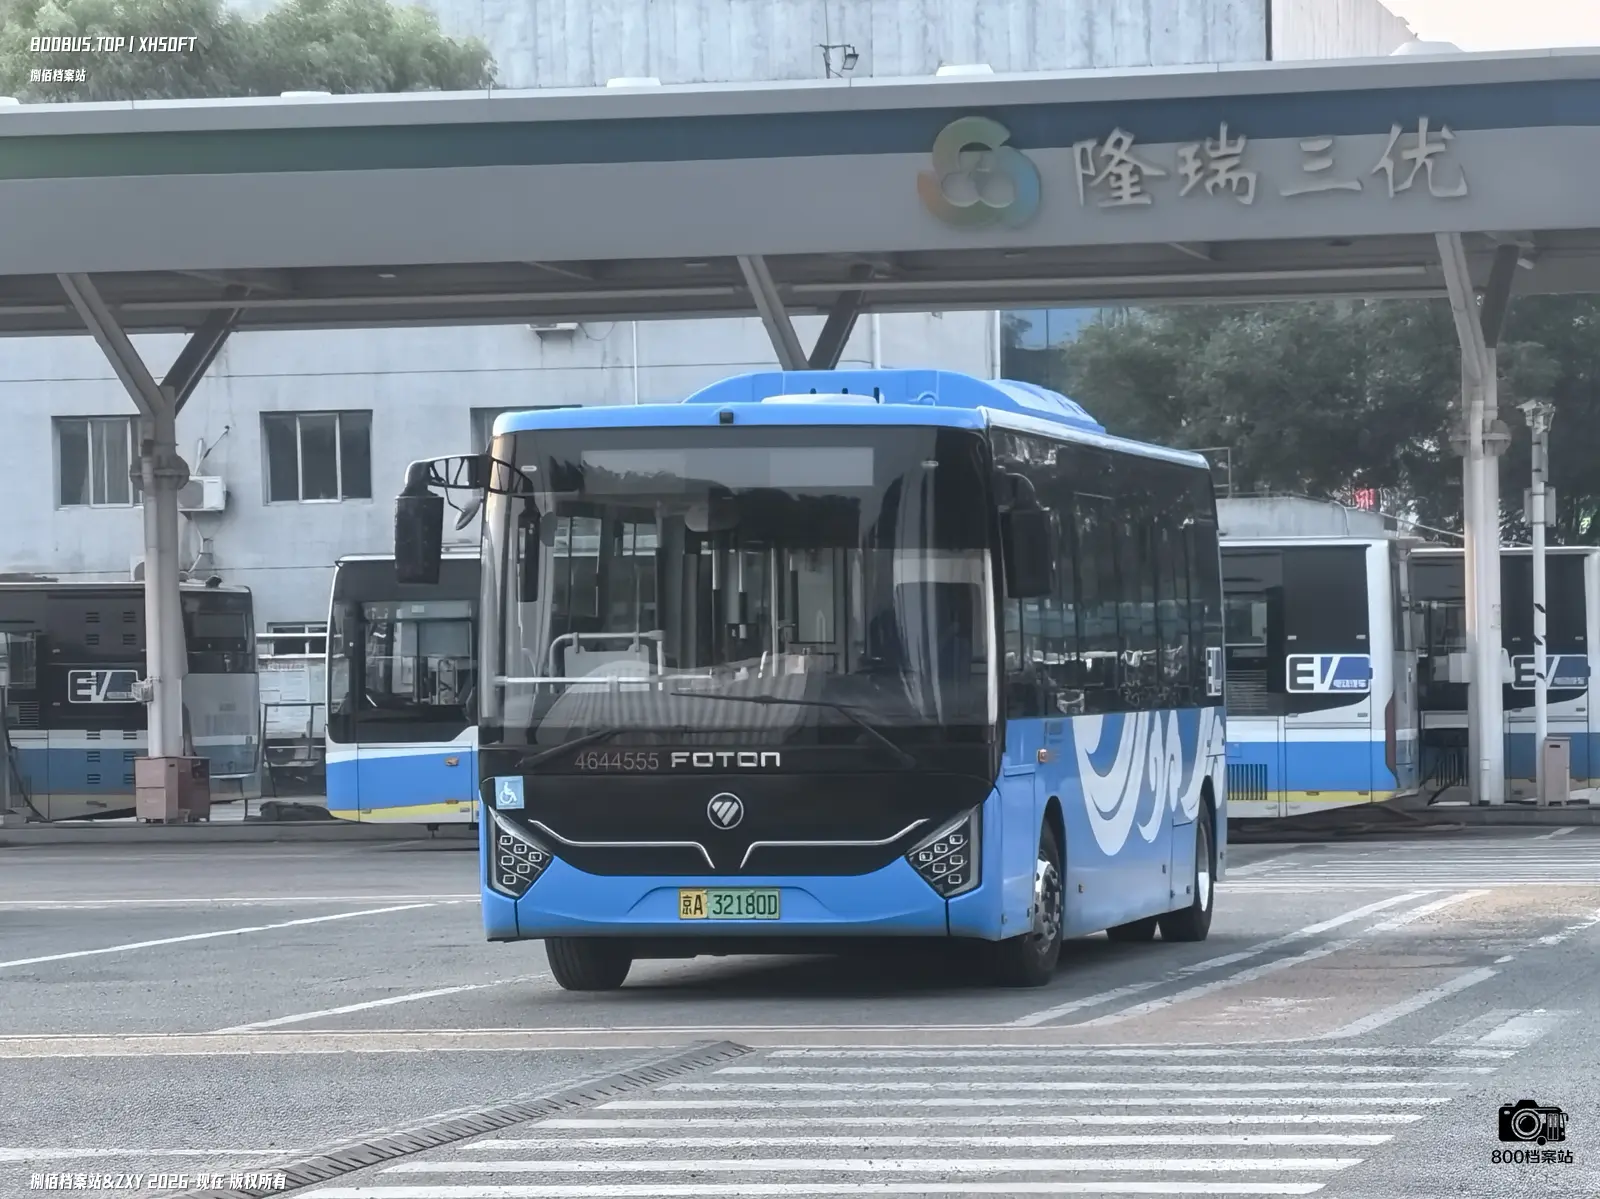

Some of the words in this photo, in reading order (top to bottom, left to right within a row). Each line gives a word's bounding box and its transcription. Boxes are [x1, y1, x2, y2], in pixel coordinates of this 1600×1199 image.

[1073, 116, 1467, 207] 隆瑞三优
[1289, 655, 1341, 692] EV
[574, 751, 659, 770] 4644555
[671, 752, 781, 767] FOTON
